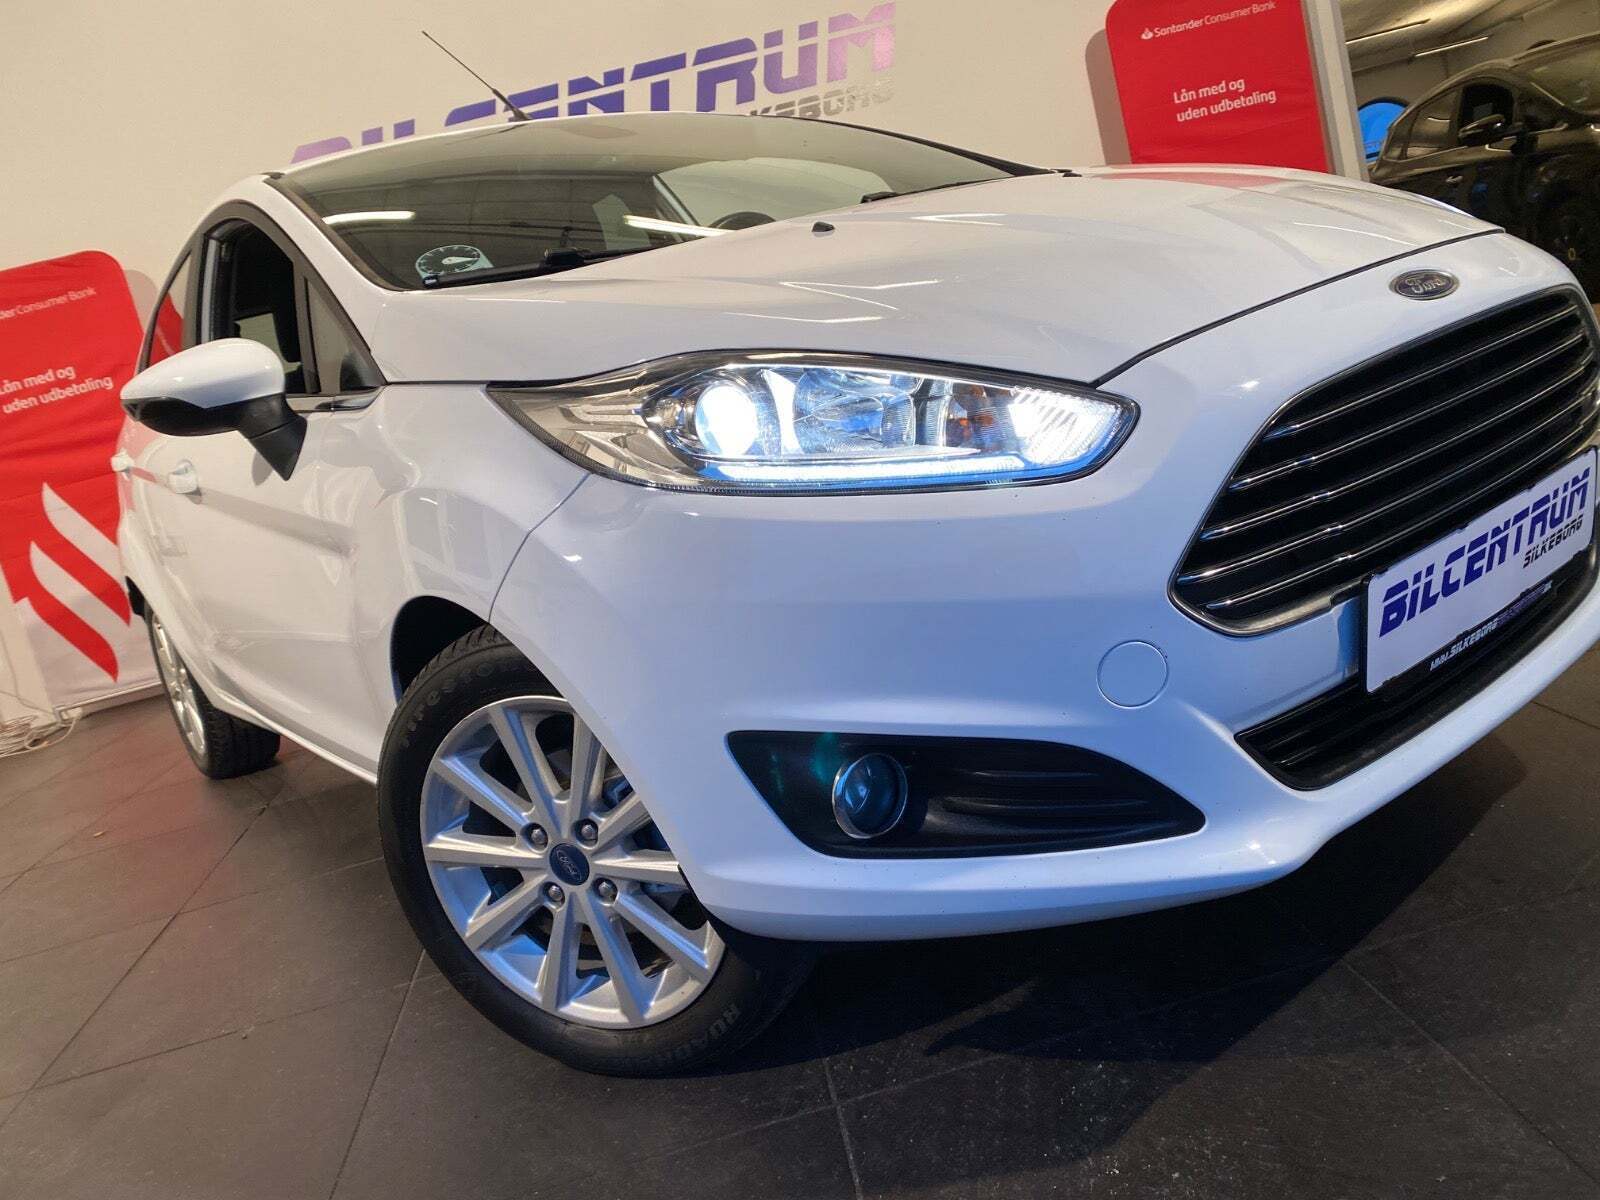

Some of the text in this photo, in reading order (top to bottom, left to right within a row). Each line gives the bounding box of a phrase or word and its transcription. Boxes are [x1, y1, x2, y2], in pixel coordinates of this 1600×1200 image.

[1154, 1, 1276, 38] Santander Consumer Bank
[1173, 78, 1245, 104] Lån med og
[1176, 90, 1276, 122] uden udbetaling
[16, 296, 69, 315] Consumer
[68, 286, 96, 301] Bank
[24, 368, 55, 388] med
[56, 366, 76, 380] og
[3, 376, 113, 413] uden udbetaling
[1379, 467, 1590, 638] BILCENTRUM
[1523, 514, 1584, 568] SILKEBORG
